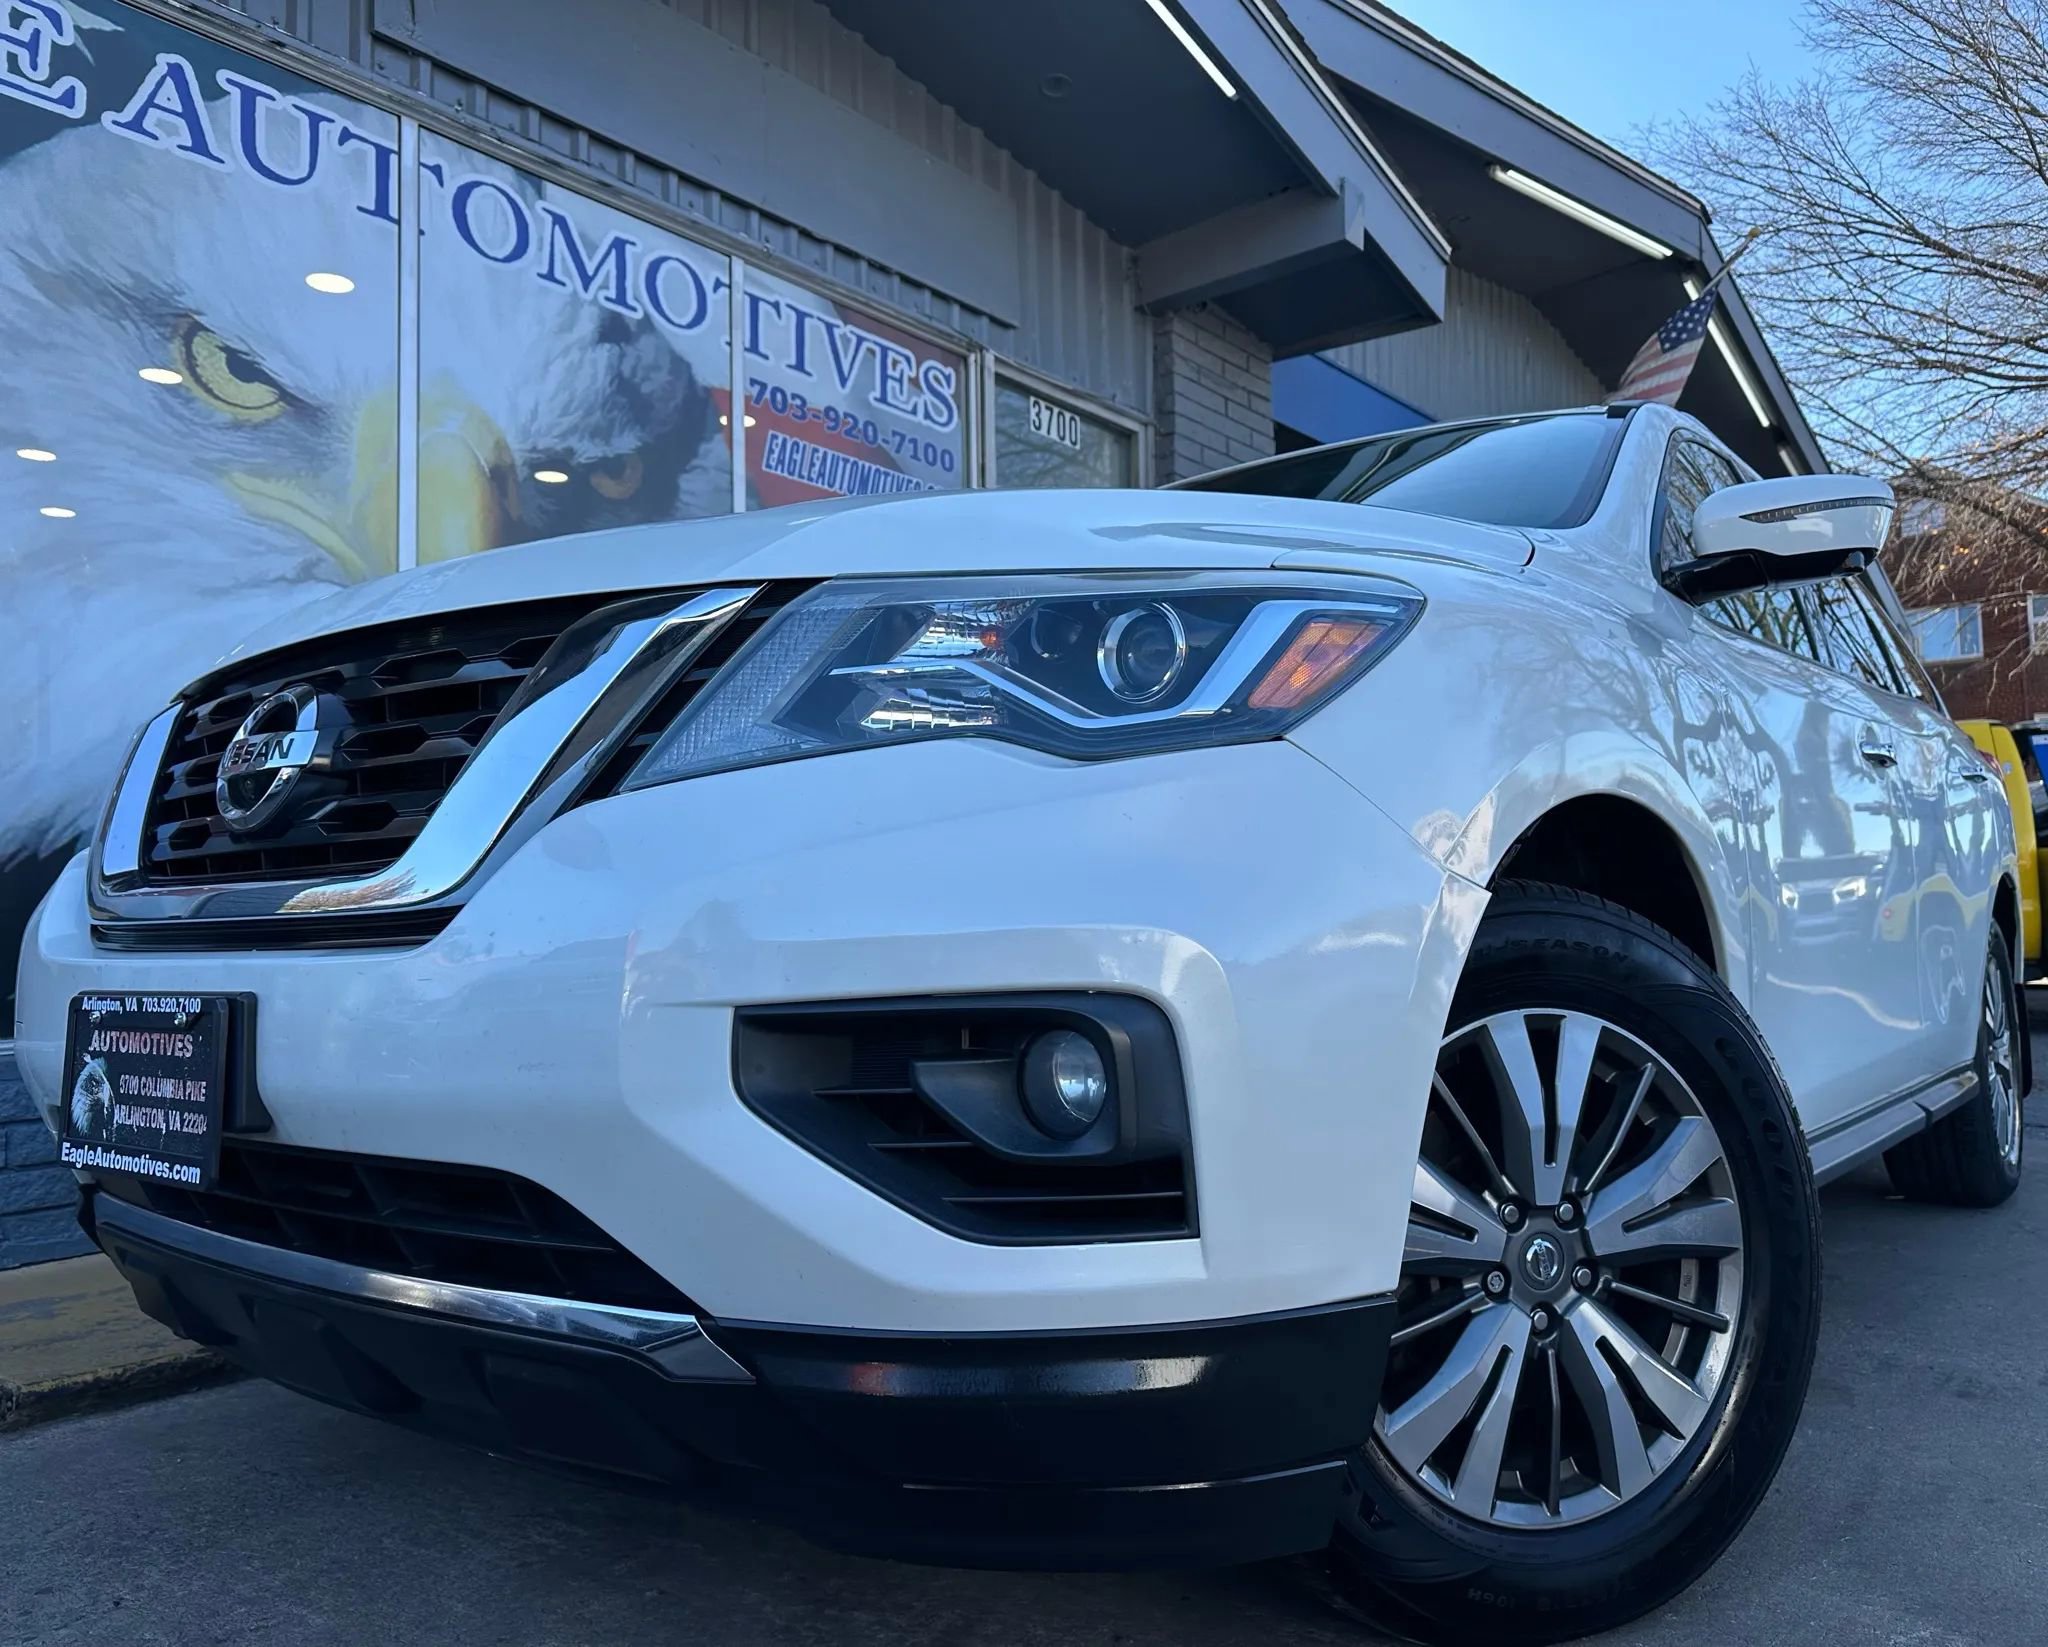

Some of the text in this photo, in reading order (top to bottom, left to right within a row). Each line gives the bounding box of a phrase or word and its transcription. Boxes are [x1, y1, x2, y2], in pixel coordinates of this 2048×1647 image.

[106, 56, 958, 430] AUTOMOTIVES
[747, 376, 955, 473] 703-920-7100
[1032, 399, 1079, 446] 3700
[82, 996, 201, 1014] Arlington, VA 703.920.7100
[90, 1029, 193, 1058] AUTOMOTIVES
[140, 1076, 184, 1100] COLUMBIA
[185, 1080, 207, 1102] PIKE
[168, 1109, 181, 1131] VA
[61, 1142, 201, 1184] EagleAutomotives.com
